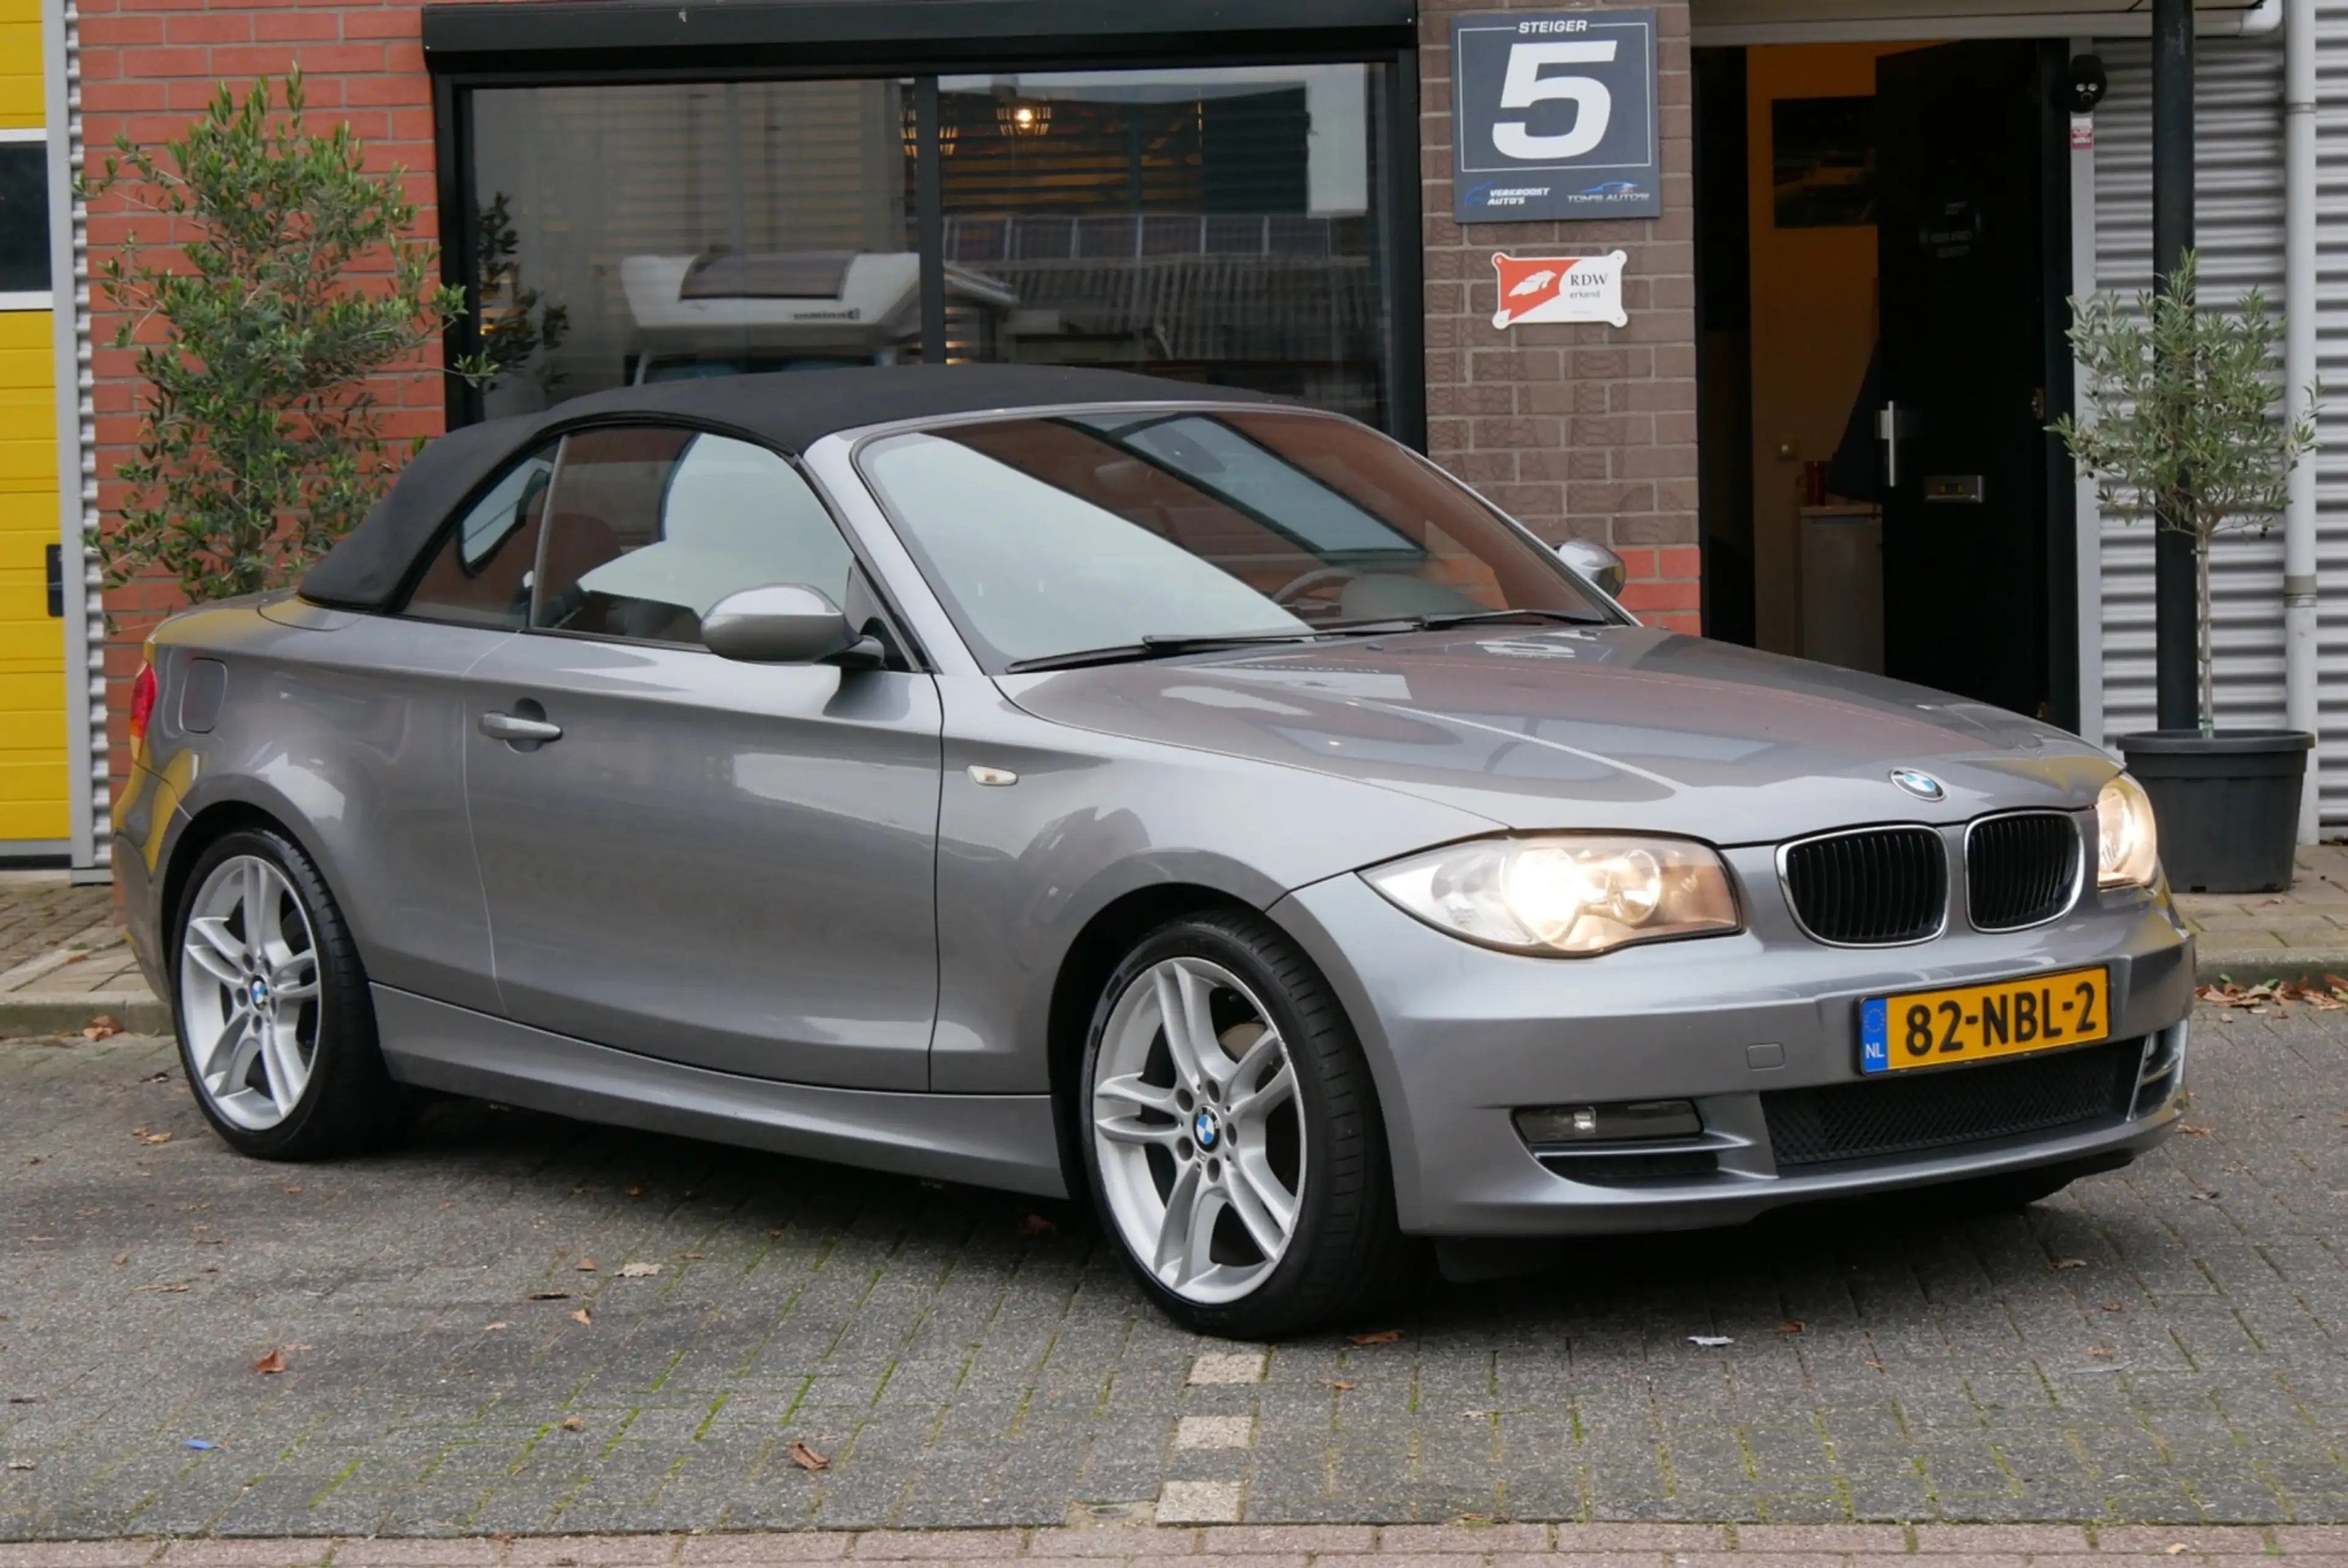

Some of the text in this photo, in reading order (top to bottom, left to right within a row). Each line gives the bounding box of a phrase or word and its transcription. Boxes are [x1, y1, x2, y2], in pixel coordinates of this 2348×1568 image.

[1518, 20, 1587, 34] STEIGER
[1492, 40, 1618, 160] 5
[1487, 196, 1525, 205] AUTO'S
[1570, 273, 1609, 286] RDW
[1569, 290, 1600, 299] erkend
[1905, 981, 2097, 1056] 82-NBL-2
[1866, 1043, 1885, 1058] NL
